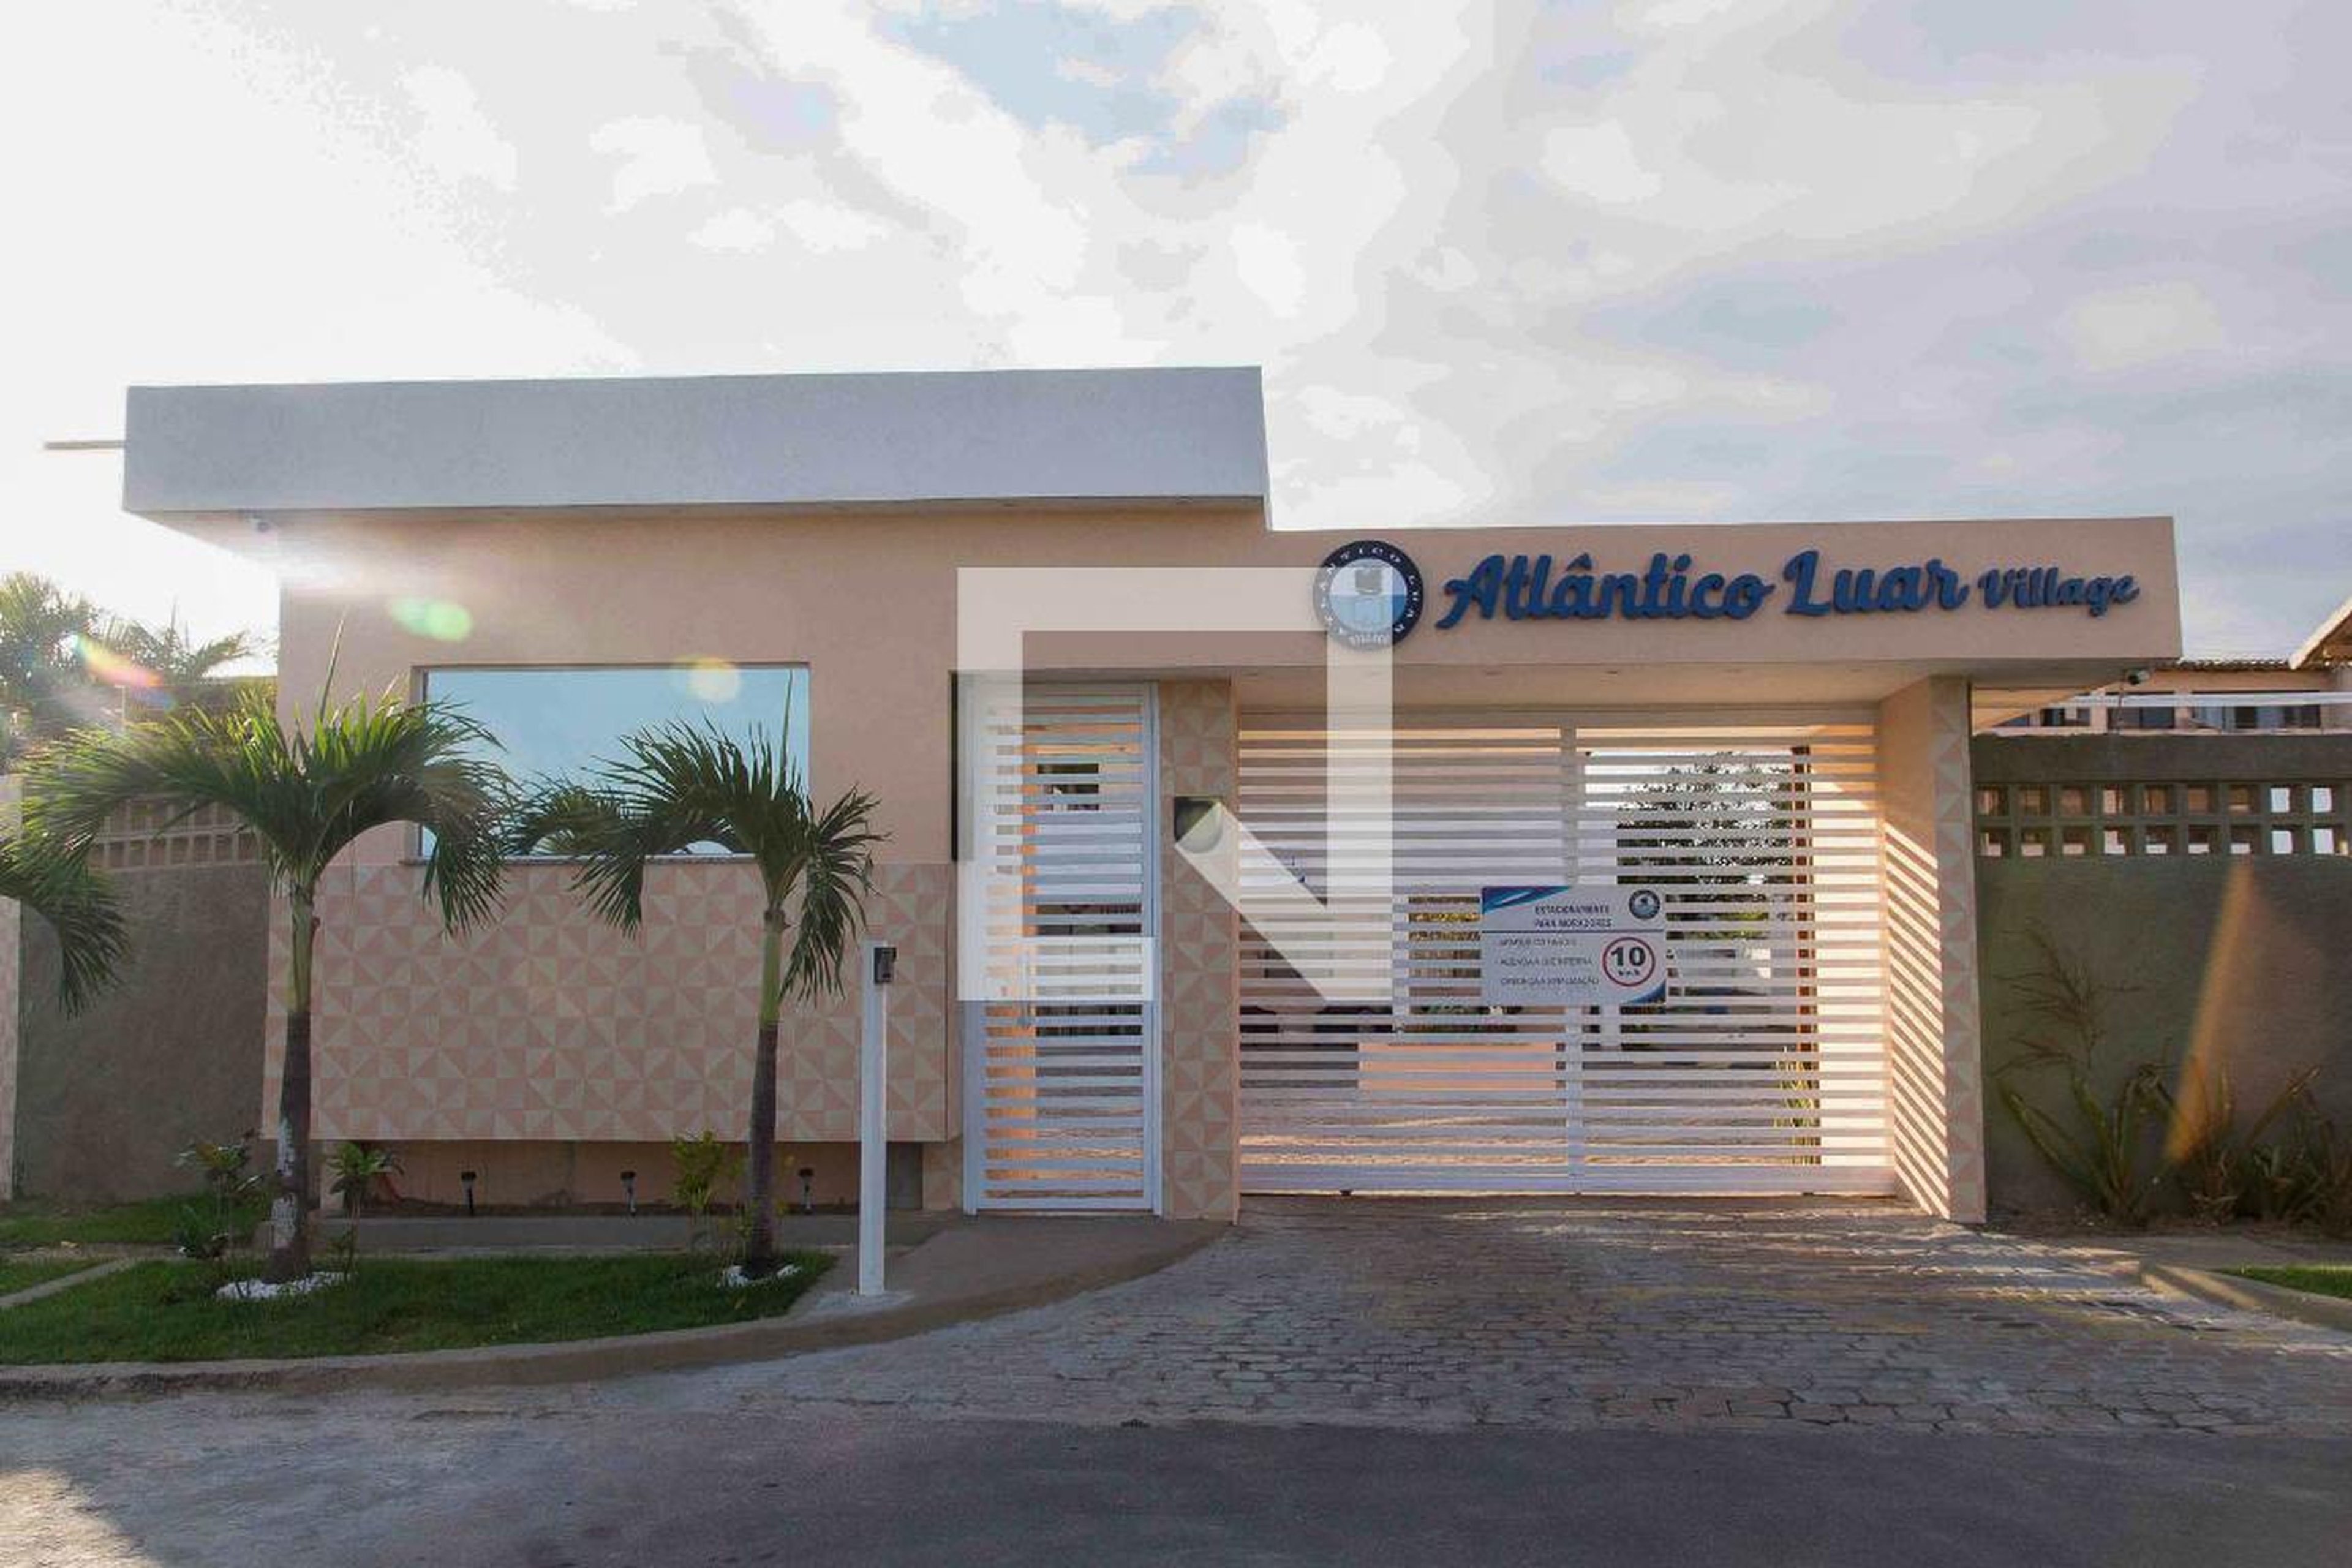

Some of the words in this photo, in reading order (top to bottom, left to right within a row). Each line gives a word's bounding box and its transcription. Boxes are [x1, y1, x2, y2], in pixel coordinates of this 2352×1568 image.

[1435, 552, 1776, 629] Atlântico
[1782, 550, 1969, 616] Luar
[1977, 566, 2140, 617] Village
[1611, 946, 1646, 967] 10
